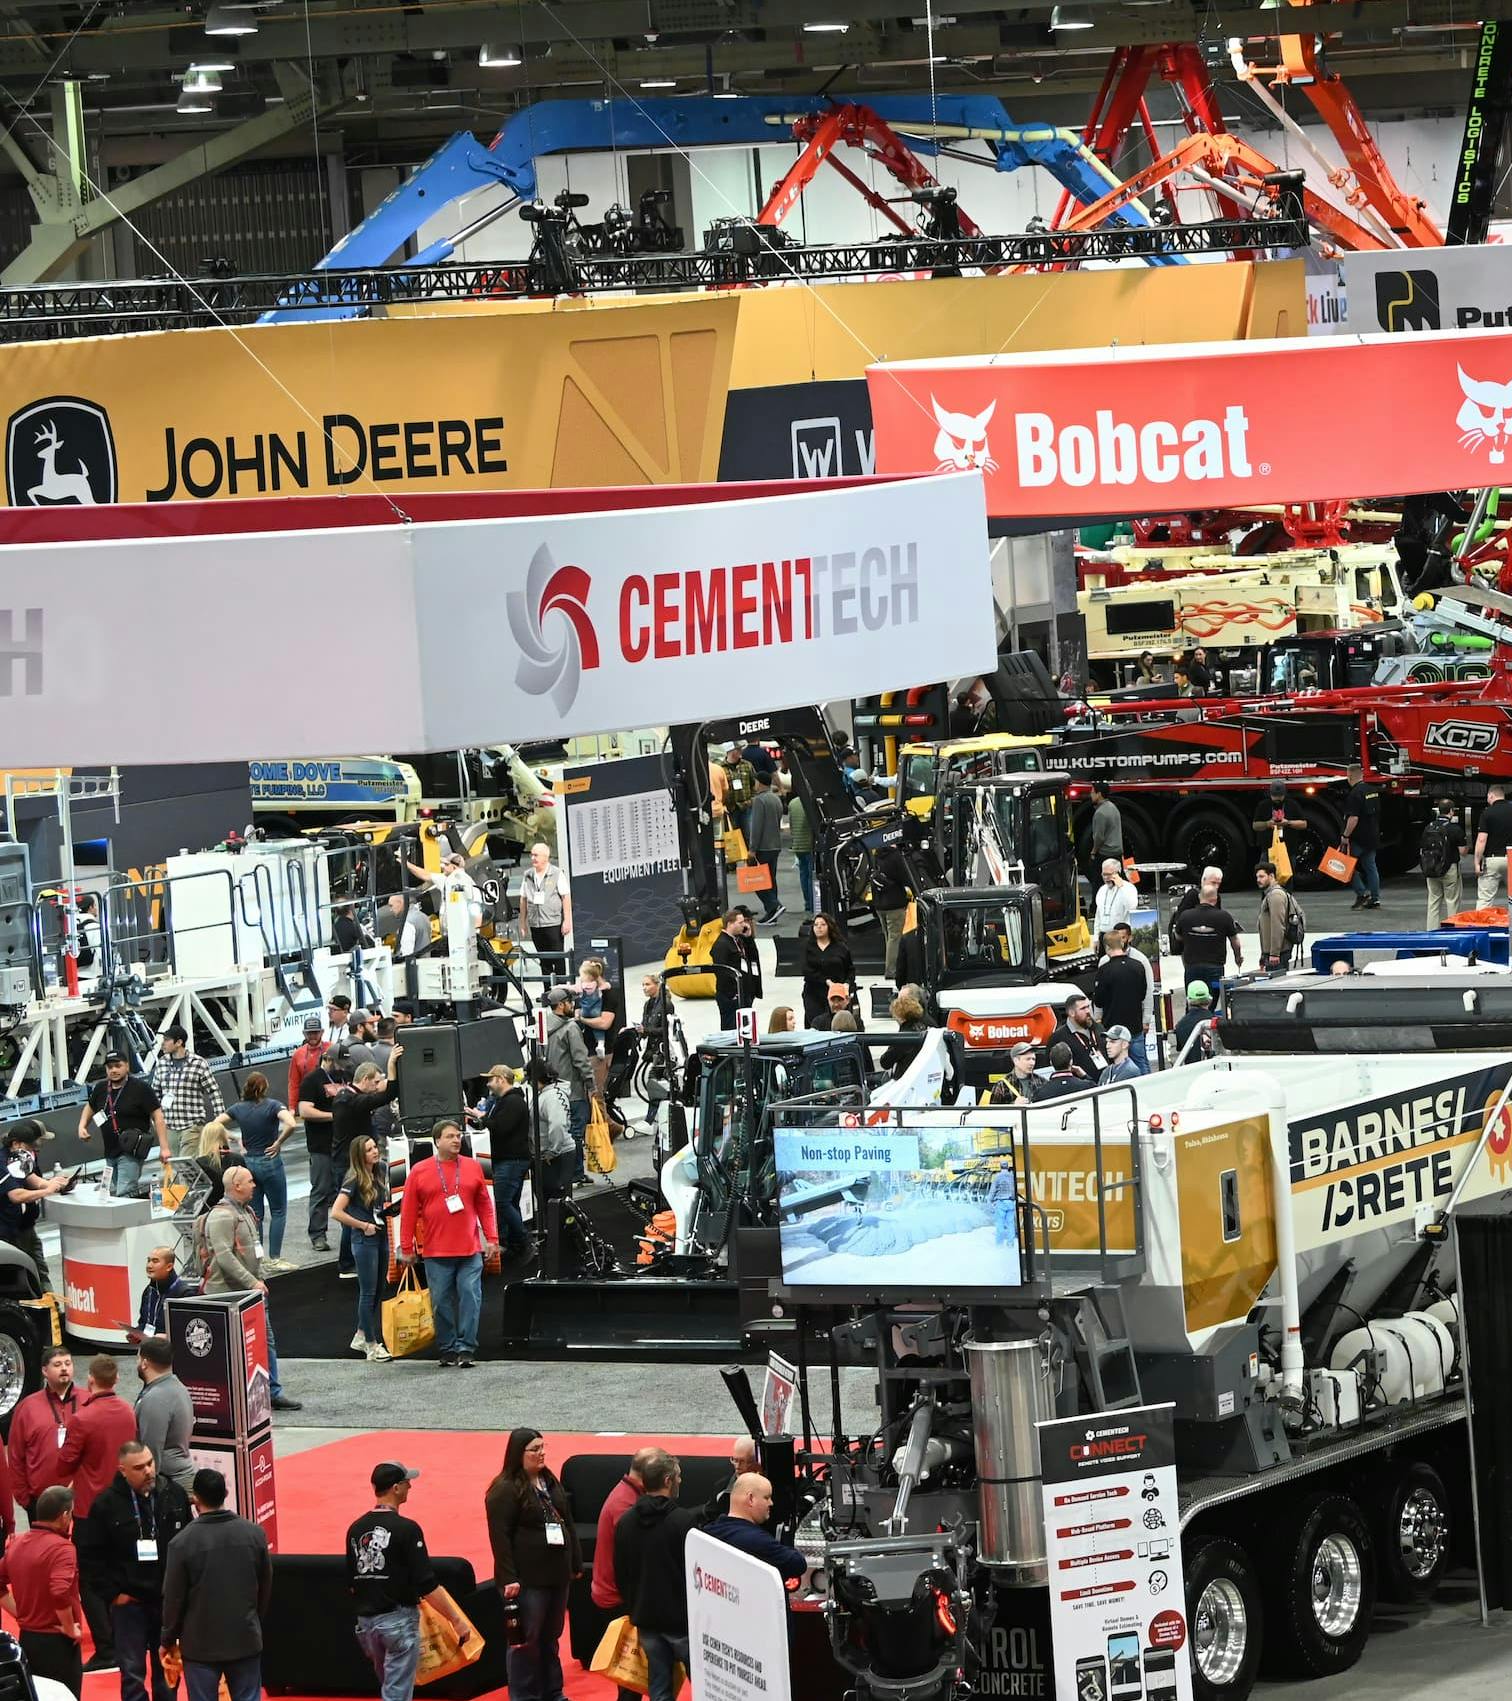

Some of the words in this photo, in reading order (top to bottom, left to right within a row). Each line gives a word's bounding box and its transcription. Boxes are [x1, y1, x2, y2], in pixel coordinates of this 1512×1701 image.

[1474, 20, 1497, 98] ONCRETE
[1457, 106, 1483, 204] LOGISTICS
[1320, 292, 1347, 324] Live
[1015, 406, 1252, 488] Bobcat
[147, 427, 309, 502] JOHN
[324, 414, 508, 486] DEERE
[1122, 633, 1171, 642] Putzmeister
[739, 718, 770, 735] DEERE
[1427, 724, 1494, 750] KCP
[293, 762, 342, 781] DOVE
[307, 784, 327, 797] LLC
[357, 780, 404, 788] Putzmeister
[883, 829, 903, 843] DEERE
[603, 862, 657, 884] EQUIPMENT
[988, 1025, 1028, 1039] Bobcat
[801, 1146, 851, 1163] Non-stop
[854, 1146, 891, 1163] Paving
[1017, 1170, 1124, 1202] ENTECH
[1078, 1458, 1099, 1467] REMOTE
[1117, 1453, 1141, 1462] SUPPORT
